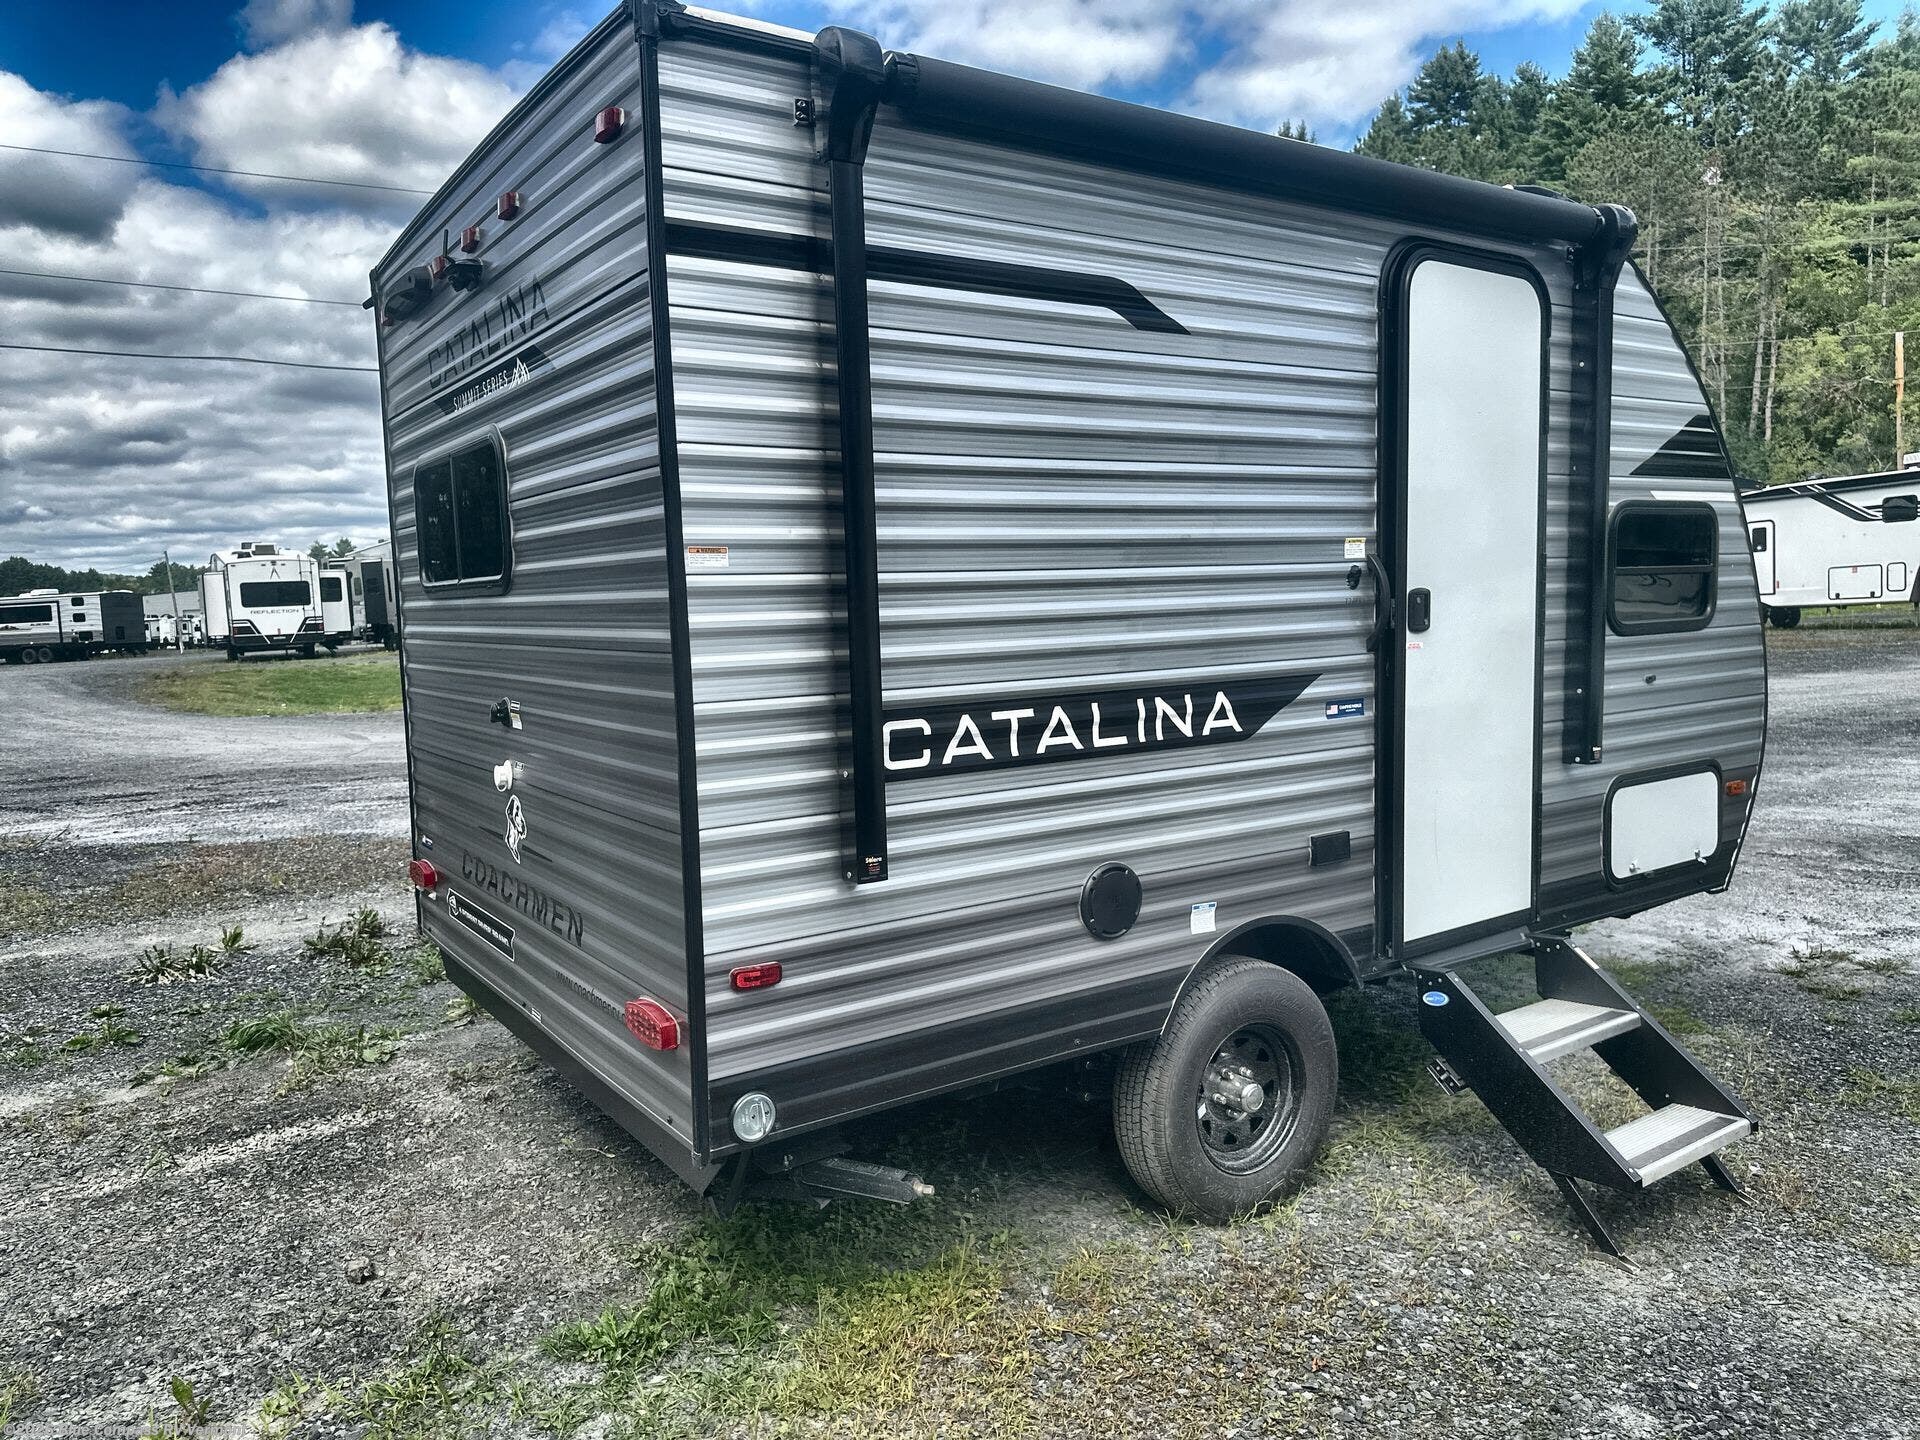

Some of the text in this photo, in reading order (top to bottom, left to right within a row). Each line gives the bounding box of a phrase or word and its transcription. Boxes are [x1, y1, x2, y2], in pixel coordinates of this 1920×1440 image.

[427, 274, 550, 389] CATALINA
[453, 370, 508, 412] SUMMIT SERIES
[882, 690, 1244, 771] CATALINA
[461, 848, 584, 947] COACHMEN
